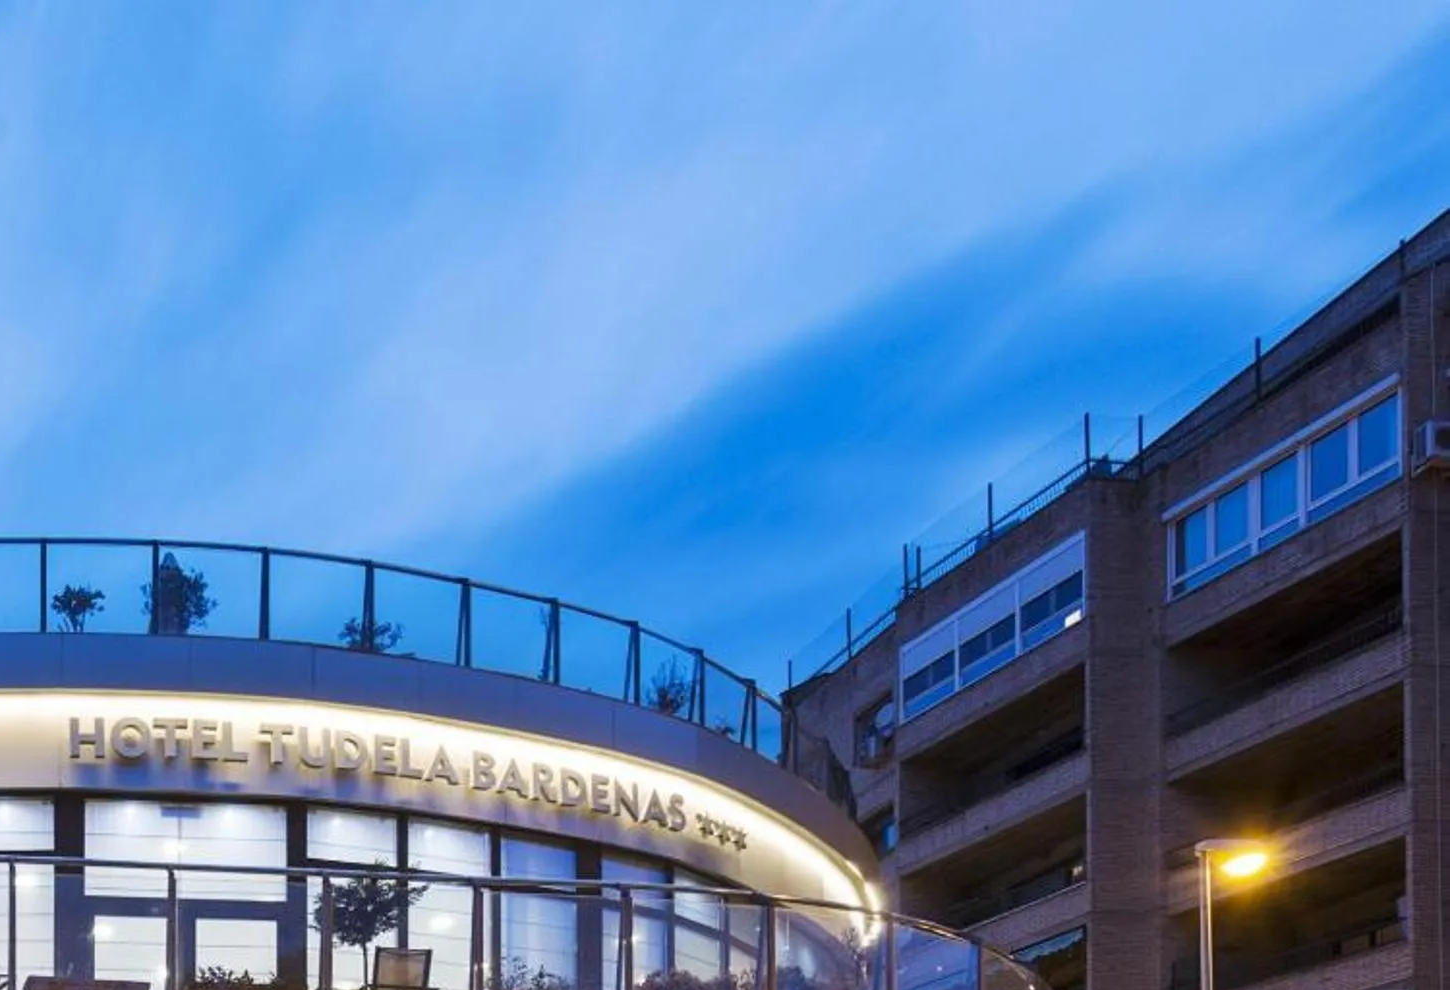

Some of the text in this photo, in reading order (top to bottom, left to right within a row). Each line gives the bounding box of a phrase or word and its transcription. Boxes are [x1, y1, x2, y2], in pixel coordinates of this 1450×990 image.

[69, 717, 687, 832] HOTEL TUDELA BARDENAS
